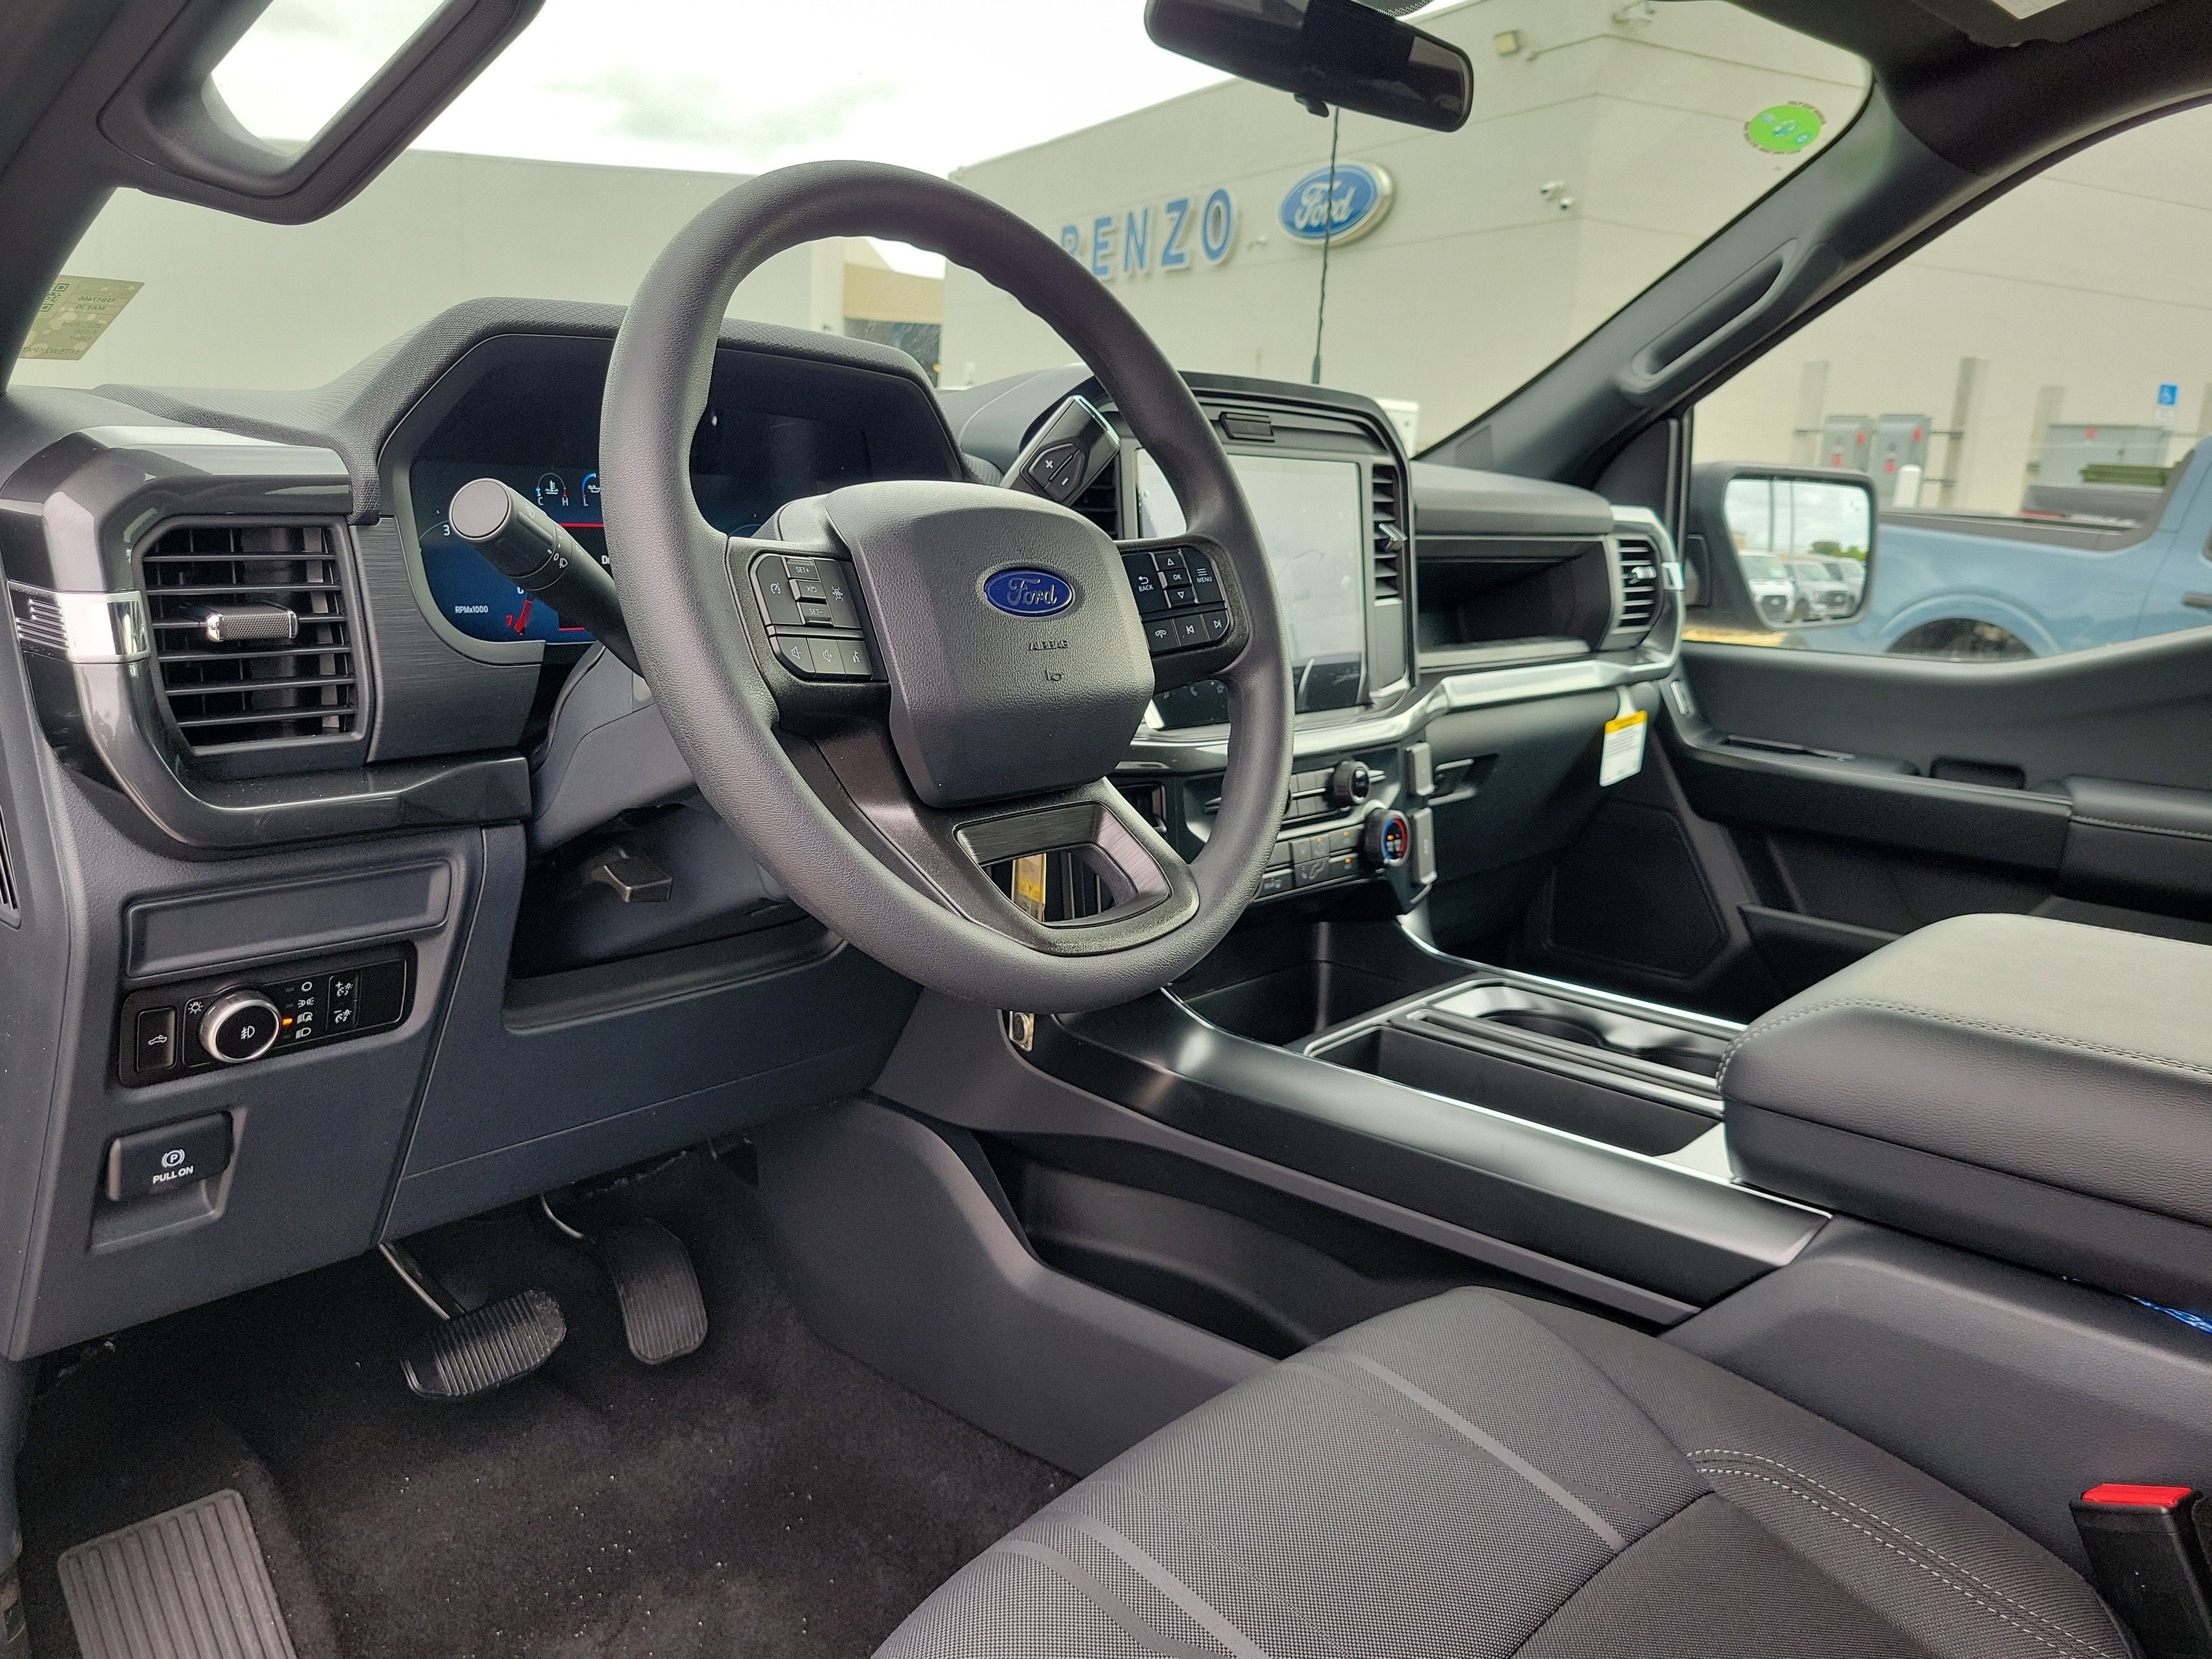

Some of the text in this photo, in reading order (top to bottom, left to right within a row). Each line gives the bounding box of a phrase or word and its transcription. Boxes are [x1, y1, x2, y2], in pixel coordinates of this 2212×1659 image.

[1294, 180, 1358, 230] Ford
[537, 496, 544, 506] C
[561, 496, 569, 506] H
[583, 496, 589, 506] L
[442, 524, 451, 536] 3
[1007, 577, 1058, 606] Ford
[455, 605, 489, 614] RPMx1000
[153, 1165, 194, 1184] PULL ON
